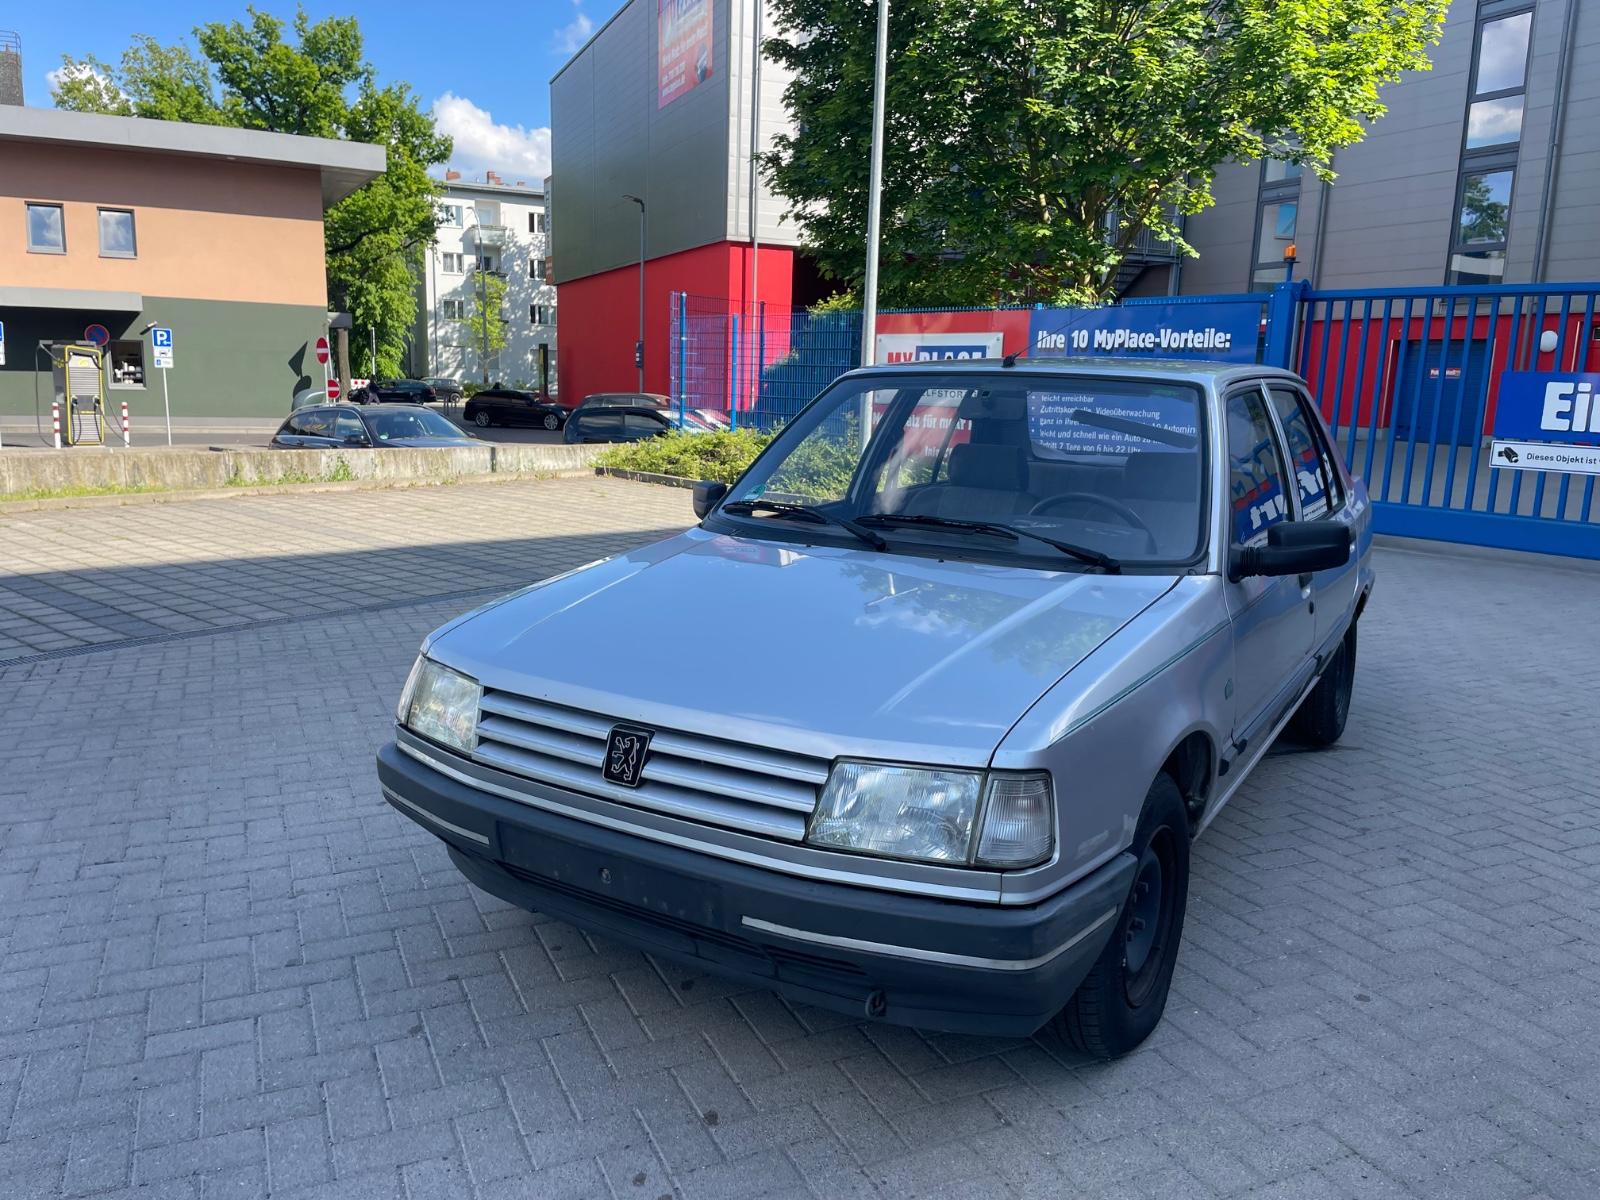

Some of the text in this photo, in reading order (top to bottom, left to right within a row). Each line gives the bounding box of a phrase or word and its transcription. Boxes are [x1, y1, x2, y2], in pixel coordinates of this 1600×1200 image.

[157, 330, 168, 346] P
[1037, 328, 1231, 350] Ihre 10 MyPlace-Vorteile:
[1526, 452, 1554, 461] Dieses
[1556, 454, 1583, 464] Objekt
[1585, 456, 1597, 465] ist
